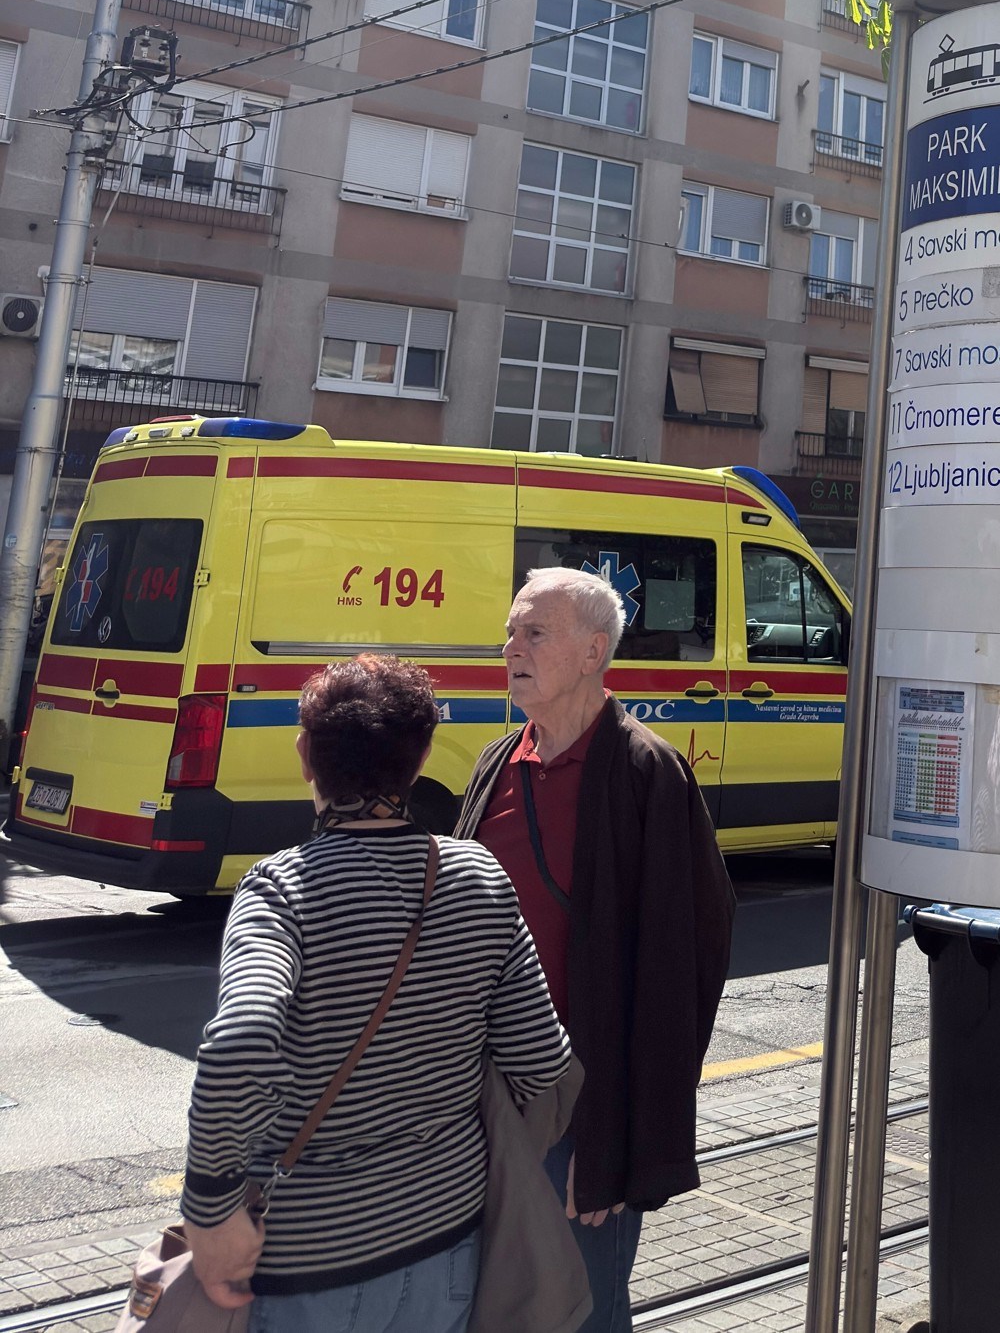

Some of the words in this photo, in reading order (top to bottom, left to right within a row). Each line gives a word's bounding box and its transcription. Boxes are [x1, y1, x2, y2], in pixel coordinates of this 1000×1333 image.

[927, 122, 988, 163] PARK
[904, 239, 914, 266] 4
[917, 229, 968, 258] Savski
[899, 290, 909, 321] 5
[913, 283, 974, 315] Prečko
[894, 348, 903, 380] 7
[904, 344, 954, 372] Savski
[891, 403, 902, 435] 11
[888, 461, 902, 494] 12
[139, 567, 180, 603] 194
[337, 597, 363, 606] HMS
[373, 566, 445, 608] 194
